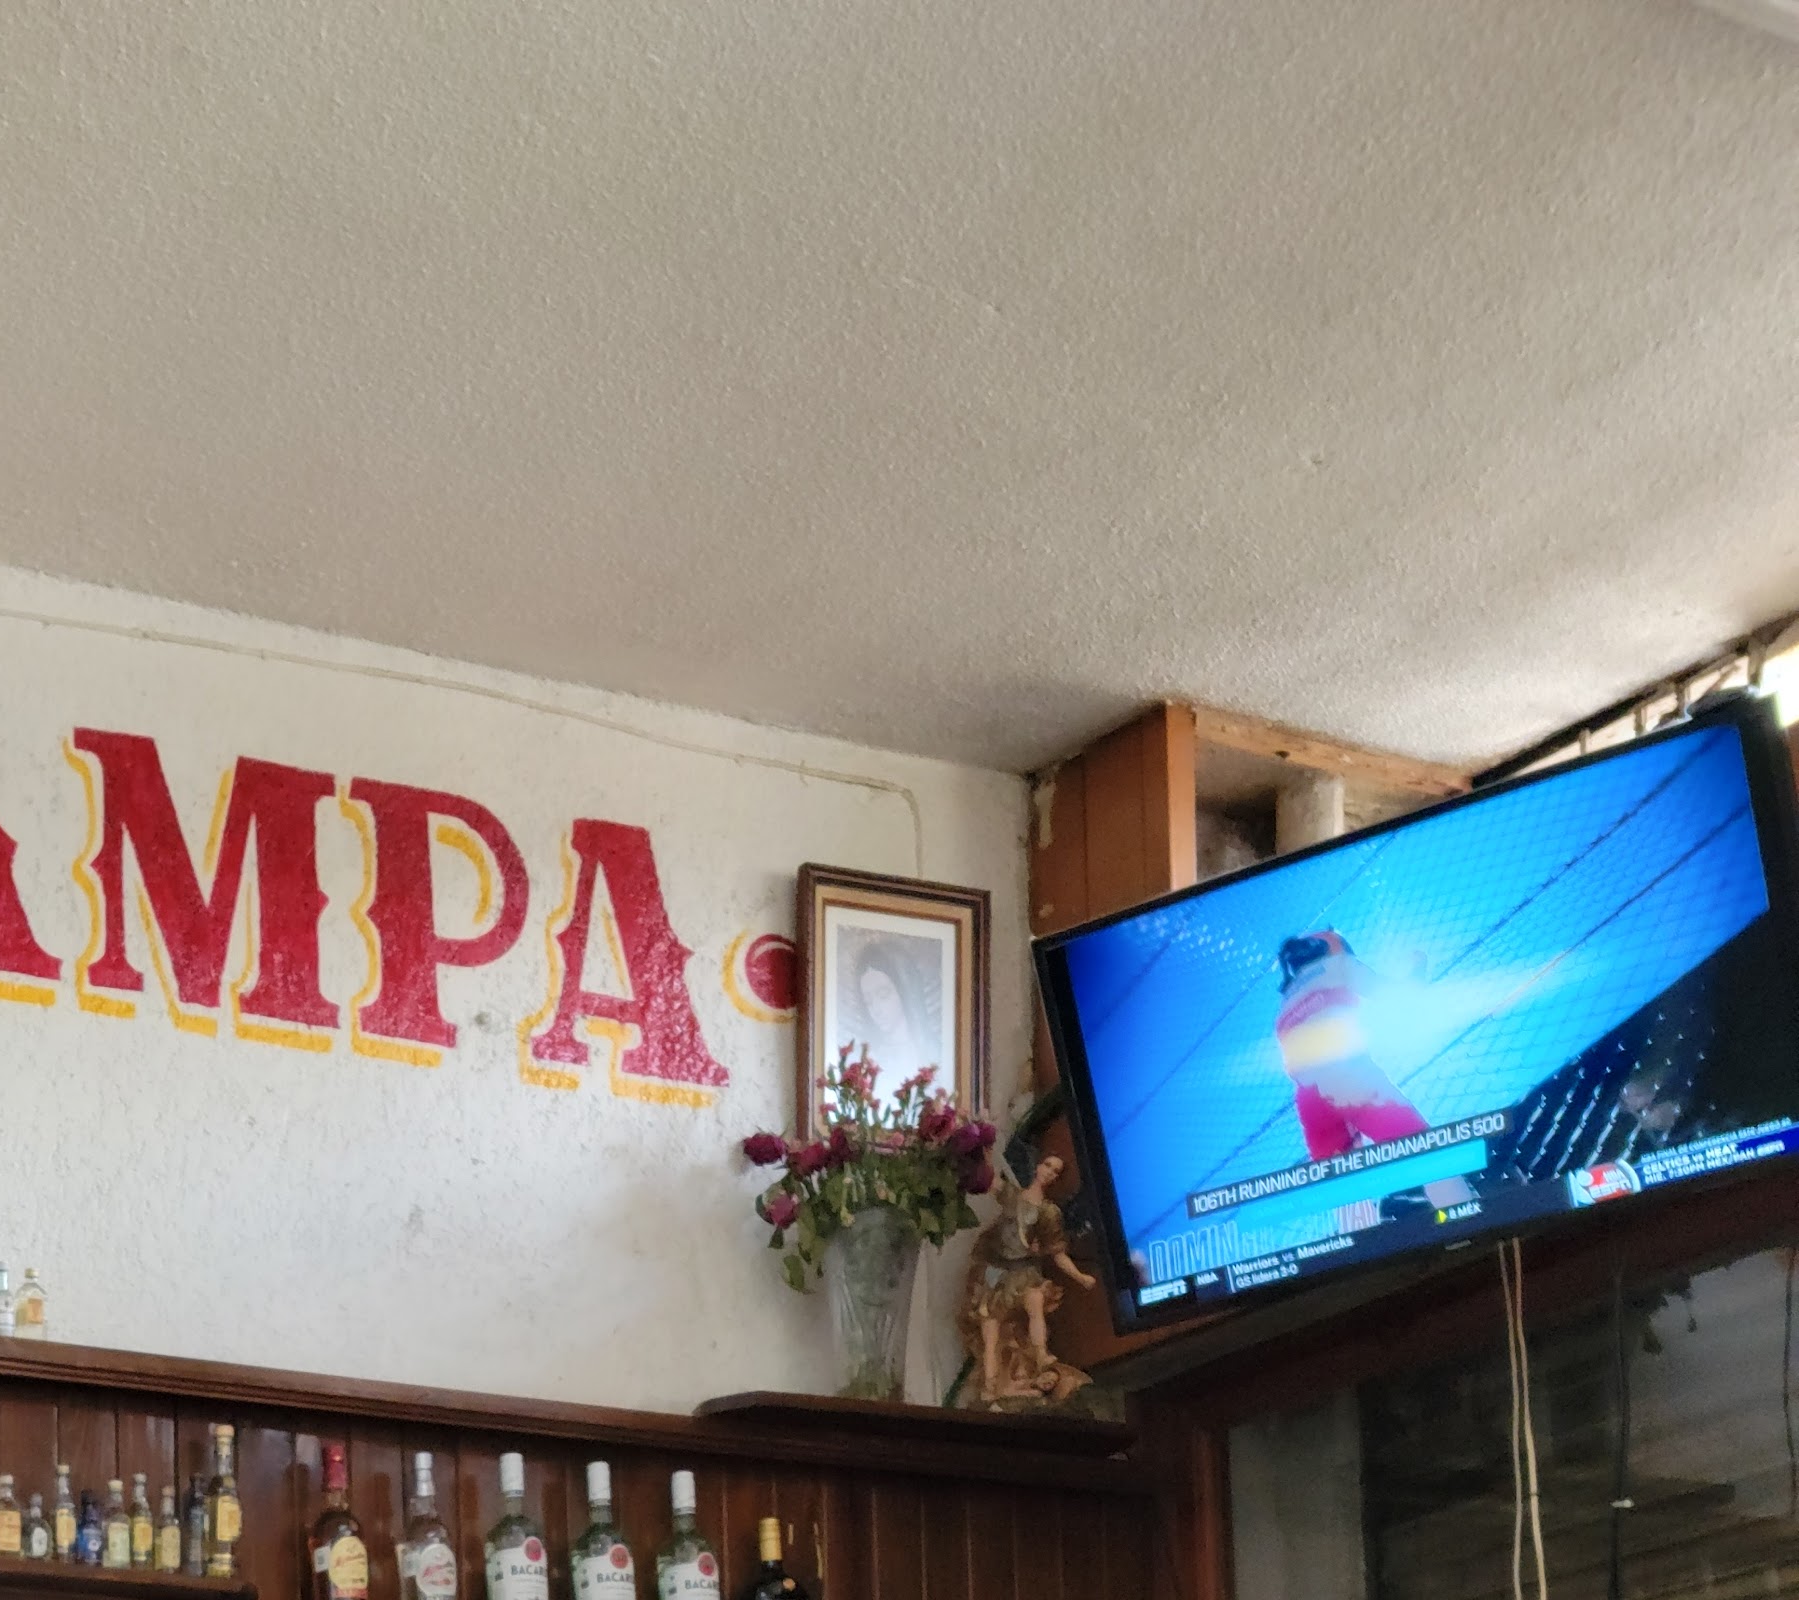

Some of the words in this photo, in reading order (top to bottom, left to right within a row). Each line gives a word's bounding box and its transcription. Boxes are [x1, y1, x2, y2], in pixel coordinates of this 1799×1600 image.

[1192, 1188, 1238, 1215] 106TH
[1239, 1167, 1309, 1200] RUNNING
[1309, 1160, 1330, 1182] OF
[1330, 1151, 1364, 1176] THE
[1364, 1122, 1472, 1166] INDIANAPOLIS
[1472, 1112, 1506, 1138] 500
[1232, 1255, 1280, 1276] Warriors
[1297, 1235, 1355, 1260] Mavericks
[1138, 1278, 1188, 1307] ESPN
[1195, 1272, 1219, 1287] NBA
